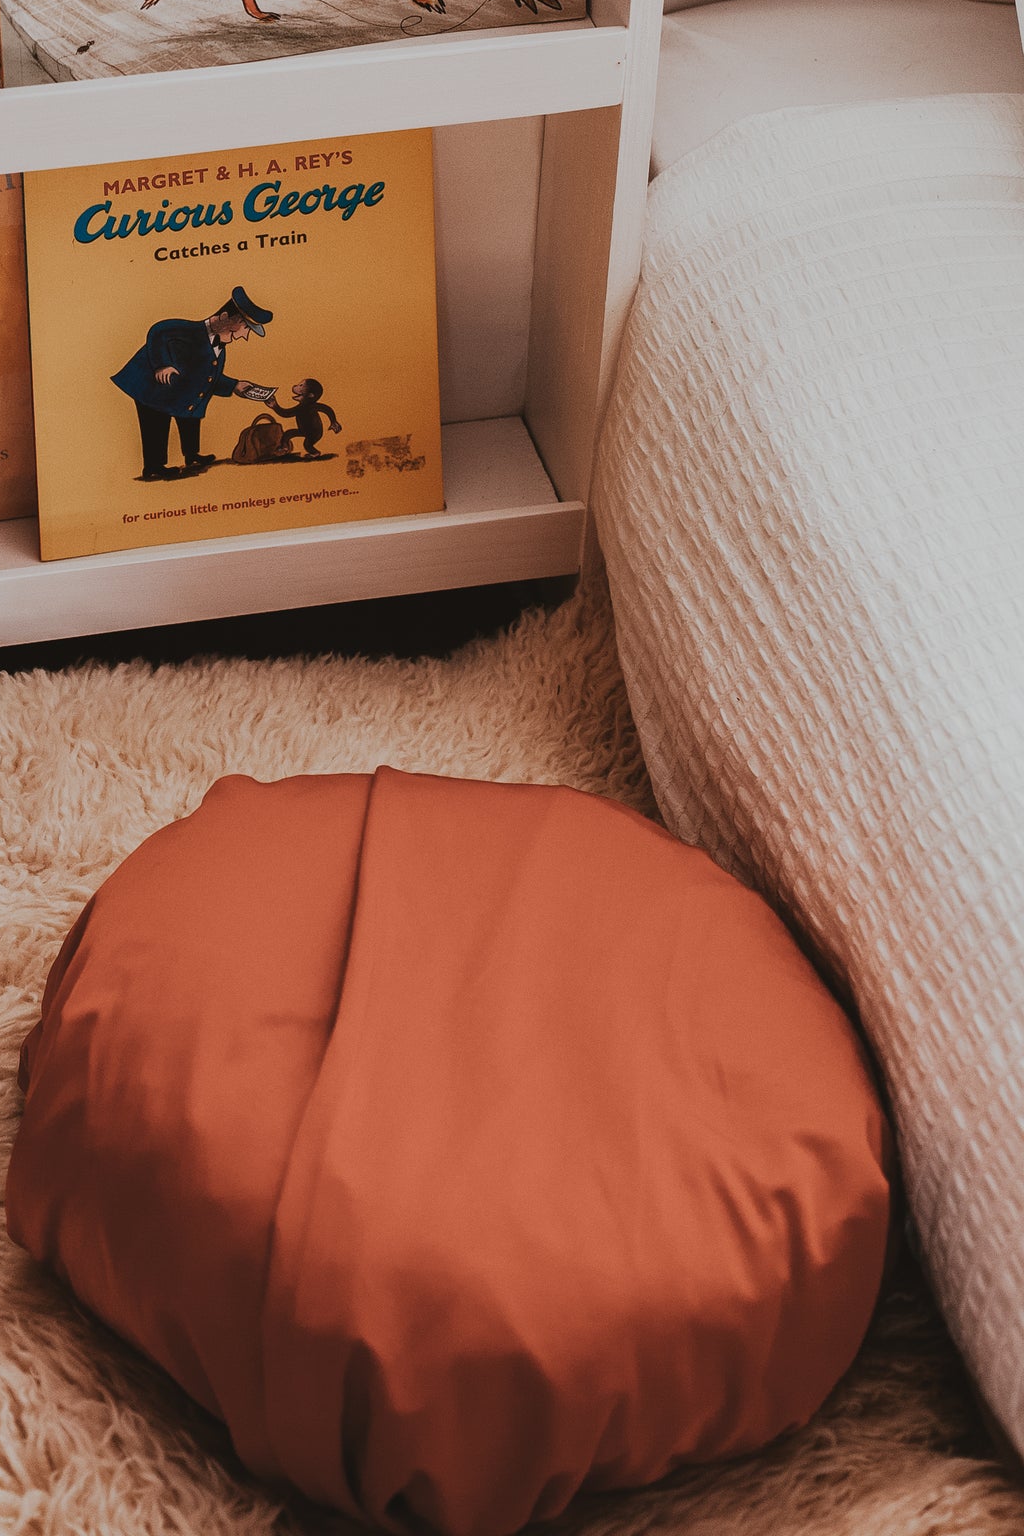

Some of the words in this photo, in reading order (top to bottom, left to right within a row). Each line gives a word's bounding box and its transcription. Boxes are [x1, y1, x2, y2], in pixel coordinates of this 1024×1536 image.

[103, 168, 209, 196] MARGRET
[215, 165, 231, 181] &
[238, 162, 259, 178] H.
[266, 159, 287, 174] A.
[295, 150, 354, 171] REY’S
[73, 199, 234, 244] Curious
[242, 180, 386, 222] George
[154, 240, 230, 262] Catches
[237, 240, 248, 251] a
[255, 230, 308, 249] Train
[122, 513, 140, 524] for
[143, 508, 187, 521] curious
[190, 504, 219, 515] little
[222, 497, 276, 511] monkeys
[279, 488, 360, 505] everywhere...
